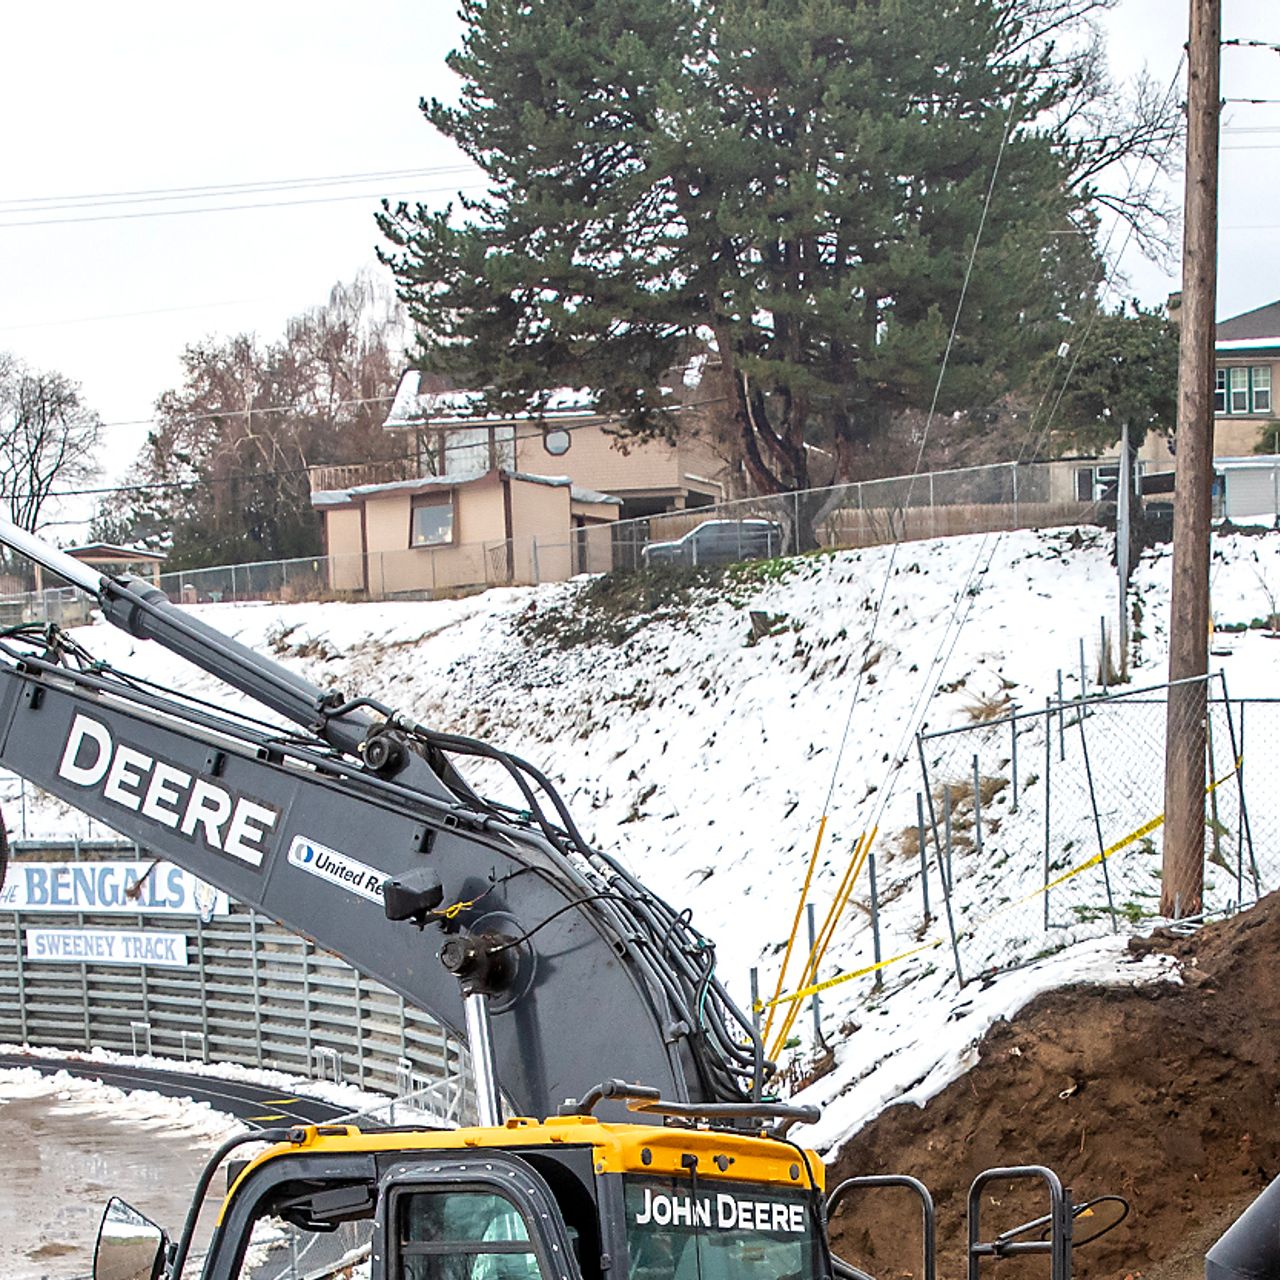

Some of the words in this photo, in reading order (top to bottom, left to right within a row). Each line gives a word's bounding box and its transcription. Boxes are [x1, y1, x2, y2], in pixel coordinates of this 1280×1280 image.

[59, 713, 278, 867] DEERE
[24, 867, 185, 909] BENGALS
[315, 852, 366, 887] United
[35, 933, 116, 957] SWEENEY
[121, 936, 176, 960] TRACK
[636, 1188, 711, 1227] JOHN
[717, 1193, 806, 1232] DEERE
